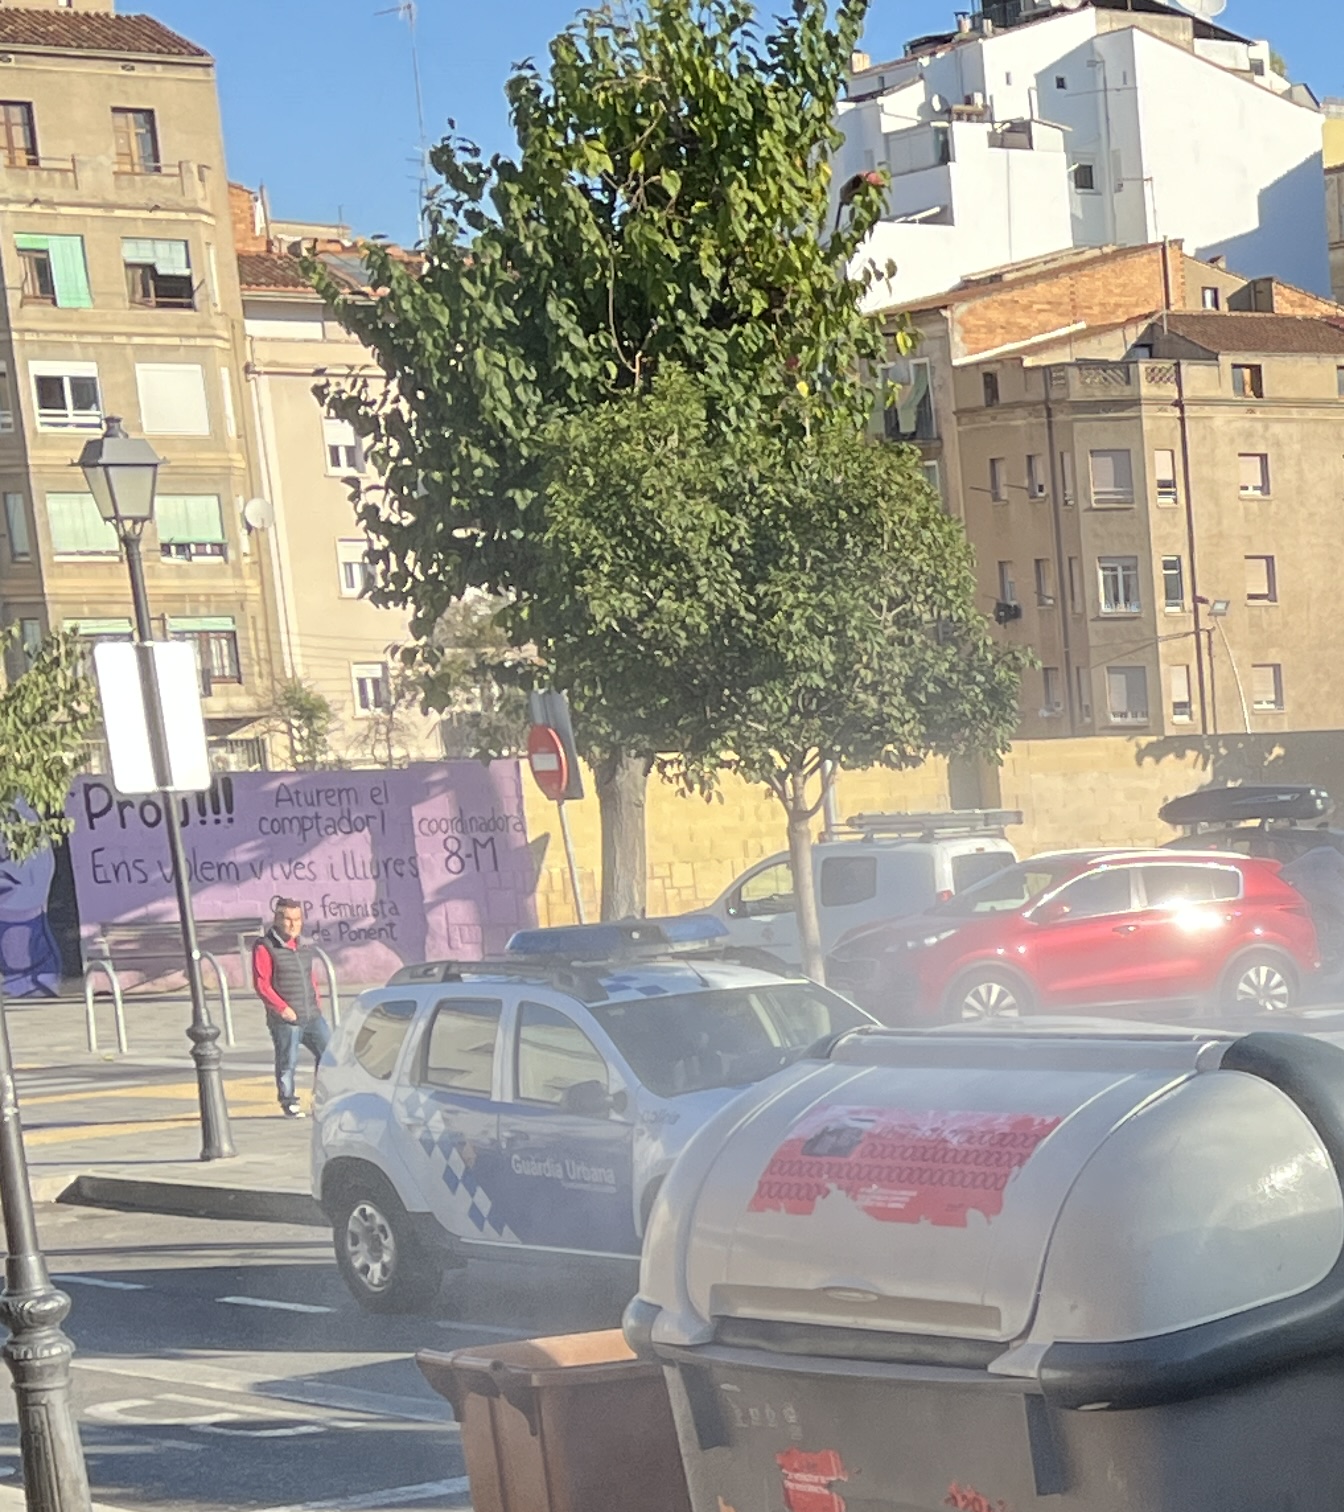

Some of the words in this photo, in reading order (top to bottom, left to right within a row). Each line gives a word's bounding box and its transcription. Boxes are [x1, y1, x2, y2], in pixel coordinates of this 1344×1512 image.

[275, 783, 358, 808] Aturem
[370, 780, 389, 806] el
[418, 806, 526, 836] coordinadora
[91, 847, 148, 885] Ens
[157, 847, 240, 885] vlem
[250, 859, 316, 882] vives
[342, 850, 420, 882] lliures
[443, 836, 499, 875] 8-M
[321, 894, 400, 920] feminista
[339, 920, 398, 941] Ponent
[564, 1159, 616, 1185] Urbana
